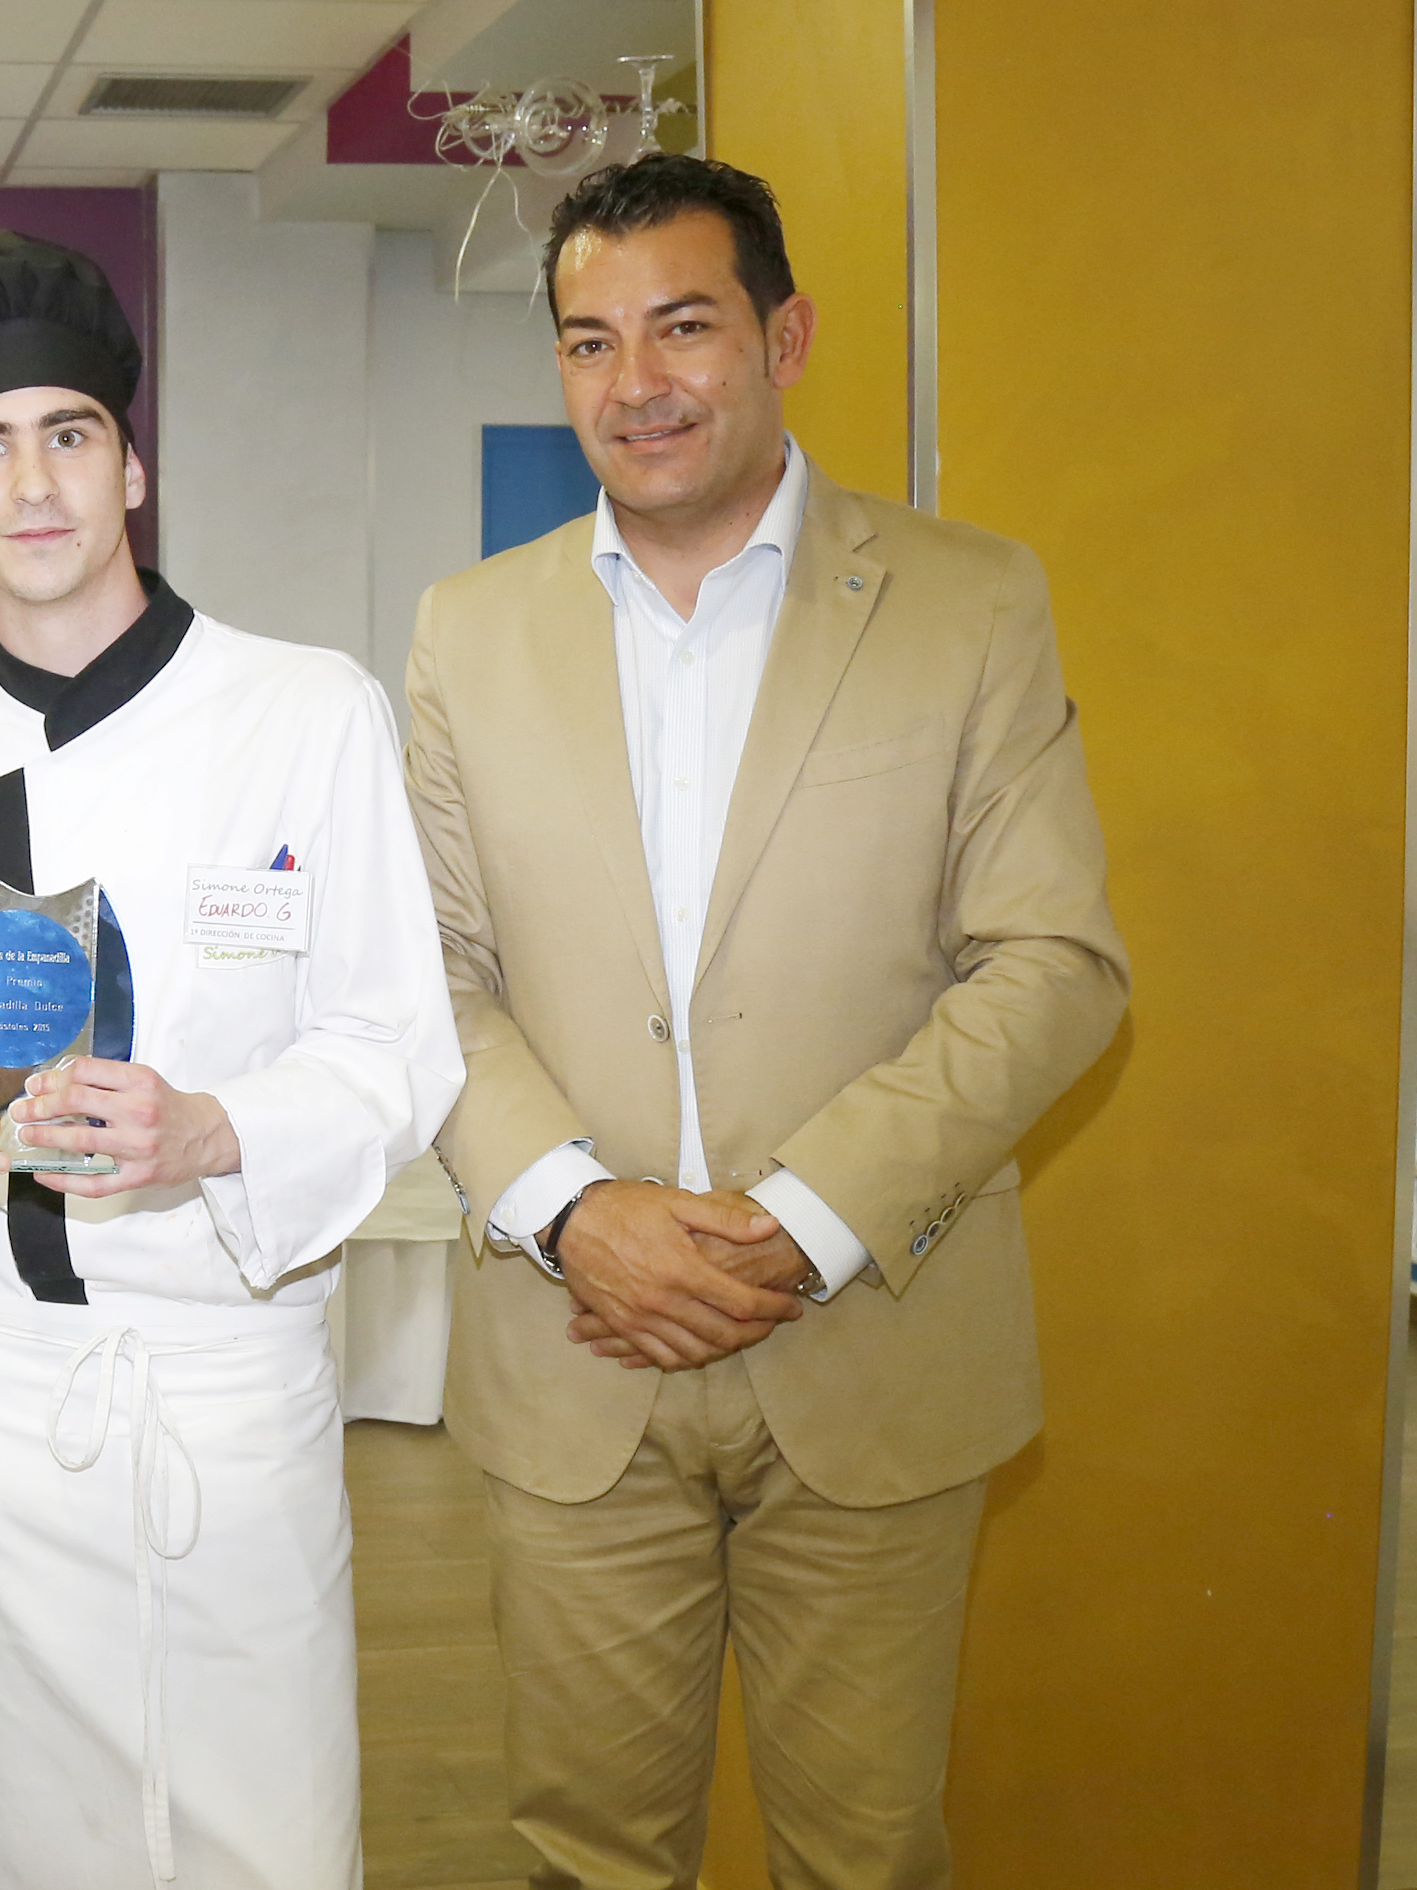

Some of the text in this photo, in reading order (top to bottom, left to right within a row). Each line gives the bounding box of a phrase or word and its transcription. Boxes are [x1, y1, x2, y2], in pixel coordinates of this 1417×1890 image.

[192, 879, 304, 899] Simone Ortega
[244, 932, 254, 940] DE
[256, 933, 285, 941] COCINA
[5, 950, 16, 961] de
[17, 950, 25, 962] la
[27, 950, 71, 965] Empanadilla
[6, 975, 43, 987] Premio
[34, 1000, 64, 1012] Dulce
